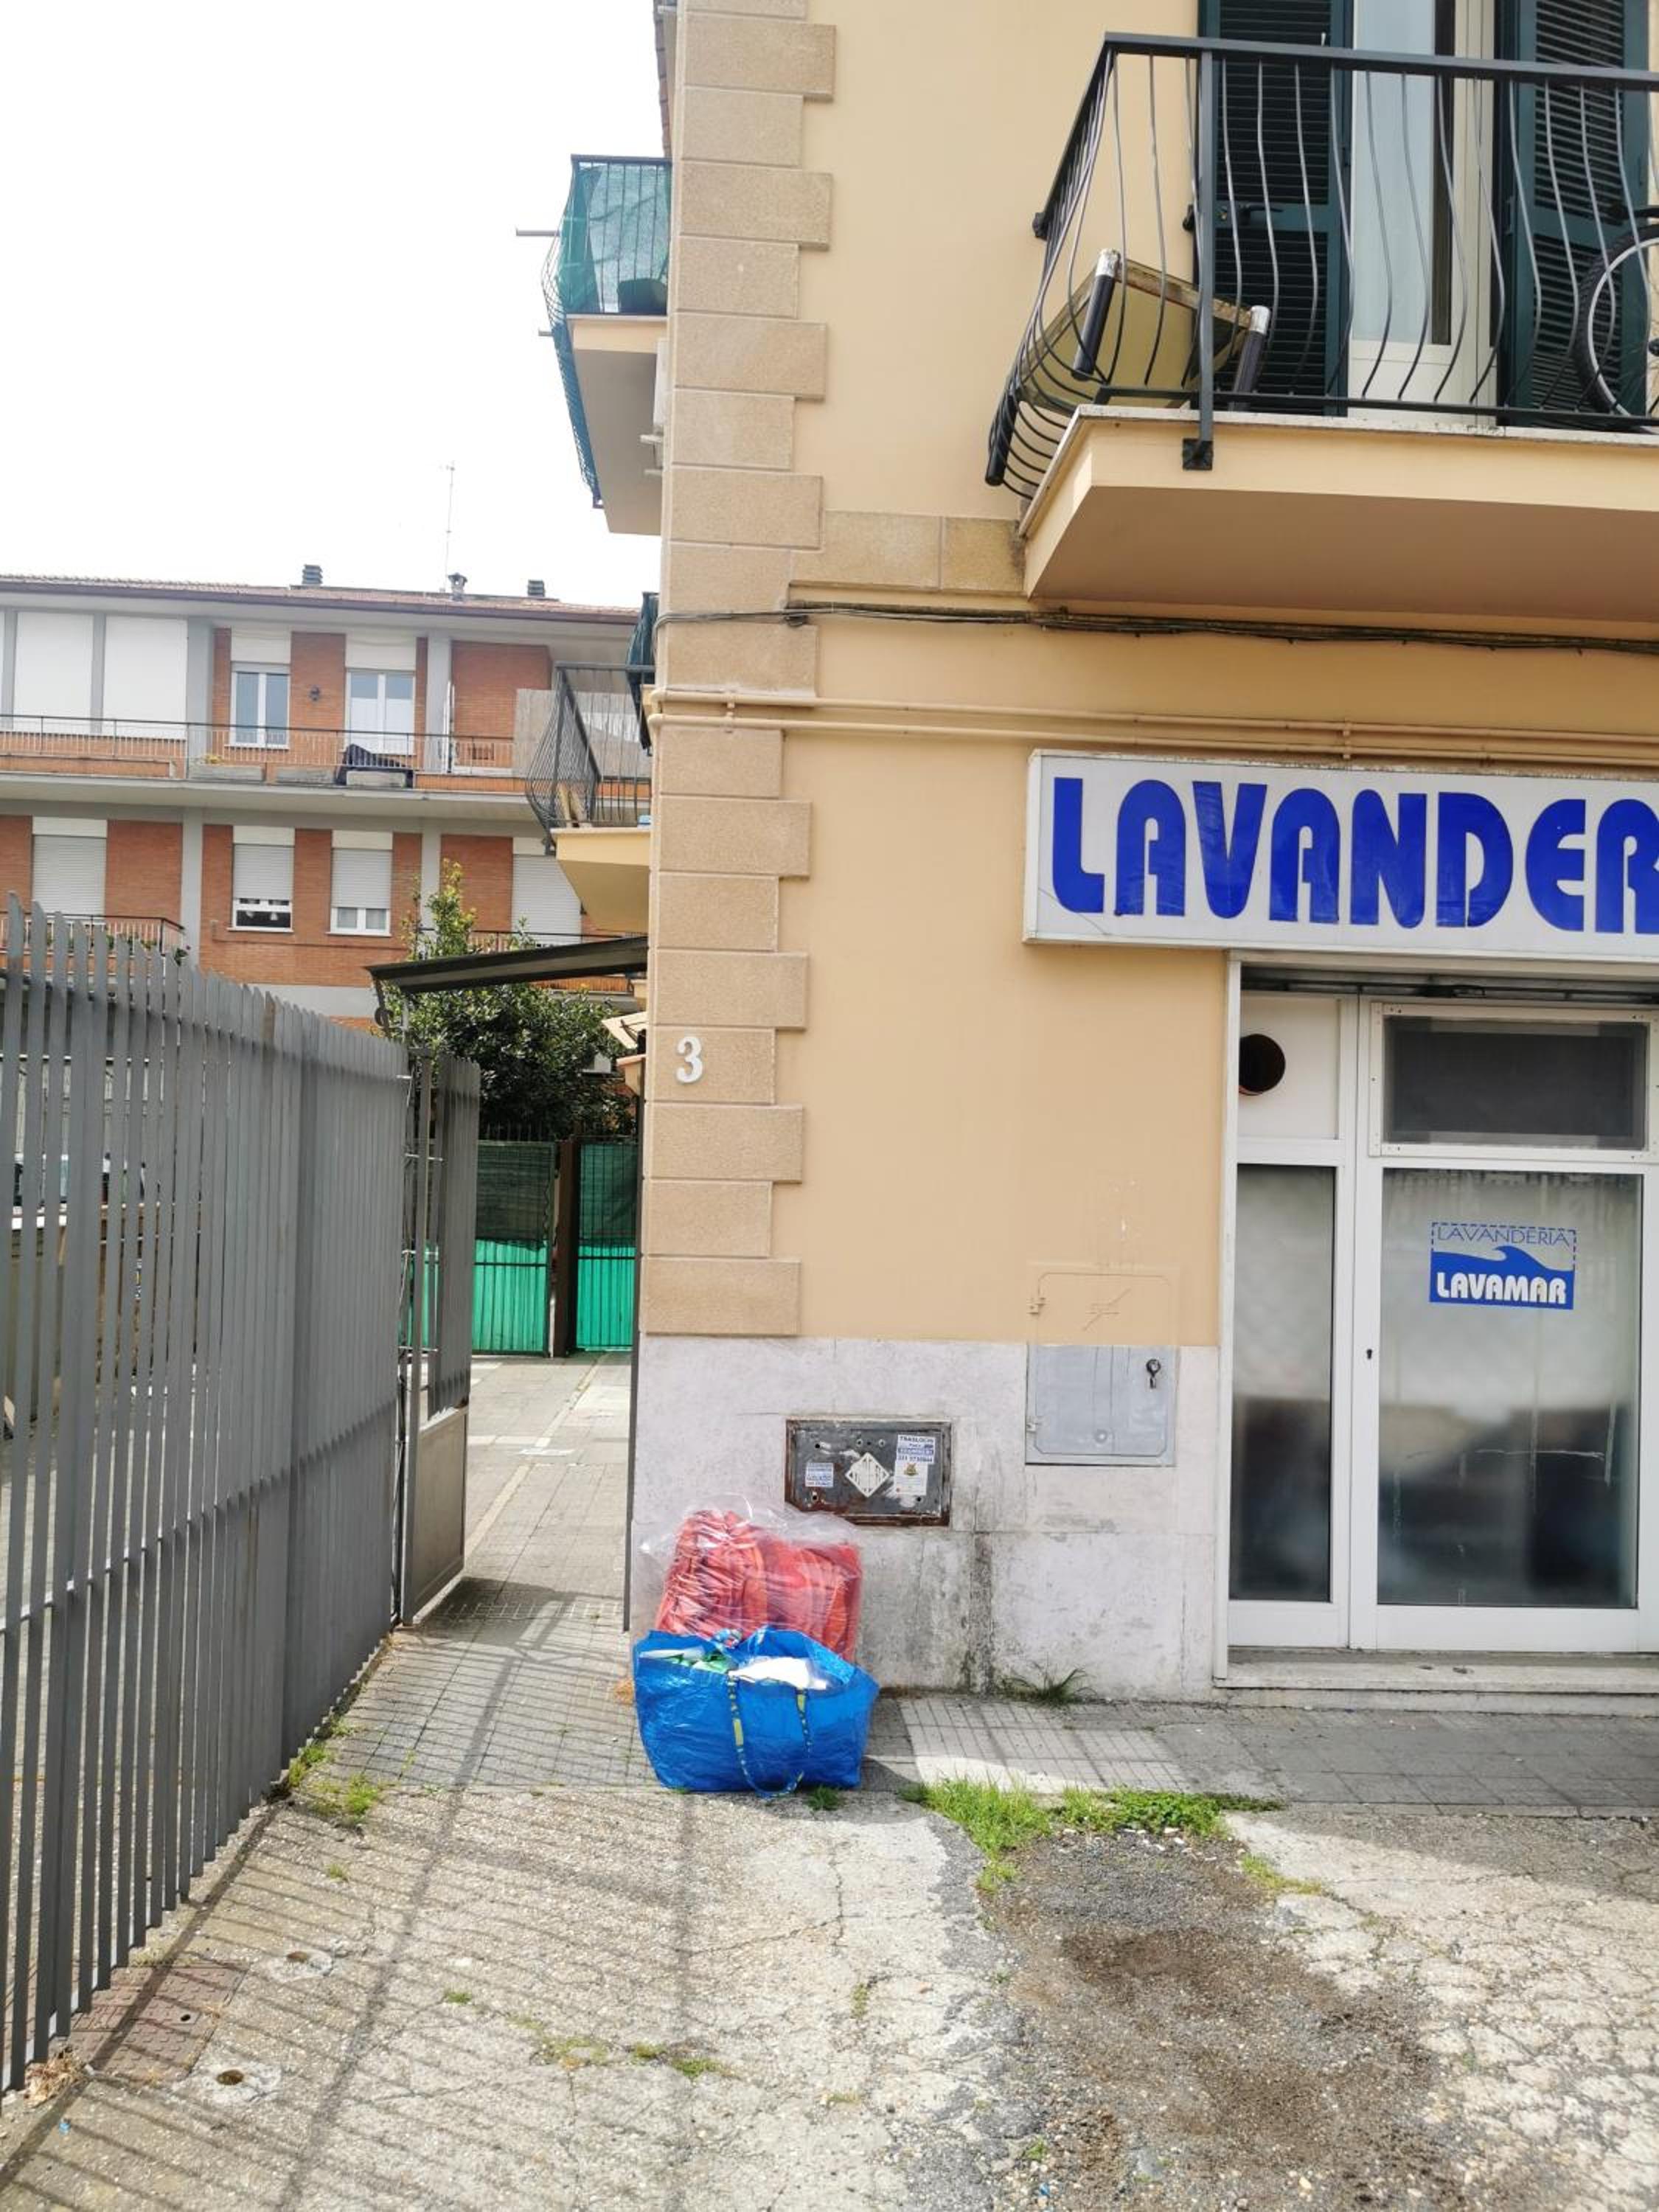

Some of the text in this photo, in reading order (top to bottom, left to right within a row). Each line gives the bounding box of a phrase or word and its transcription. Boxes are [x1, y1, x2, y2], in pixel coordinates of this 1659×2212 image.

[1051, 776, 1659, 934] LAVANDER
[676, 1037, 703, 1083] 3
[1438, 1227, 1570, 1247] LAVANDERIA
[1437, 1272, 1566, 1304] LAVAMAR
